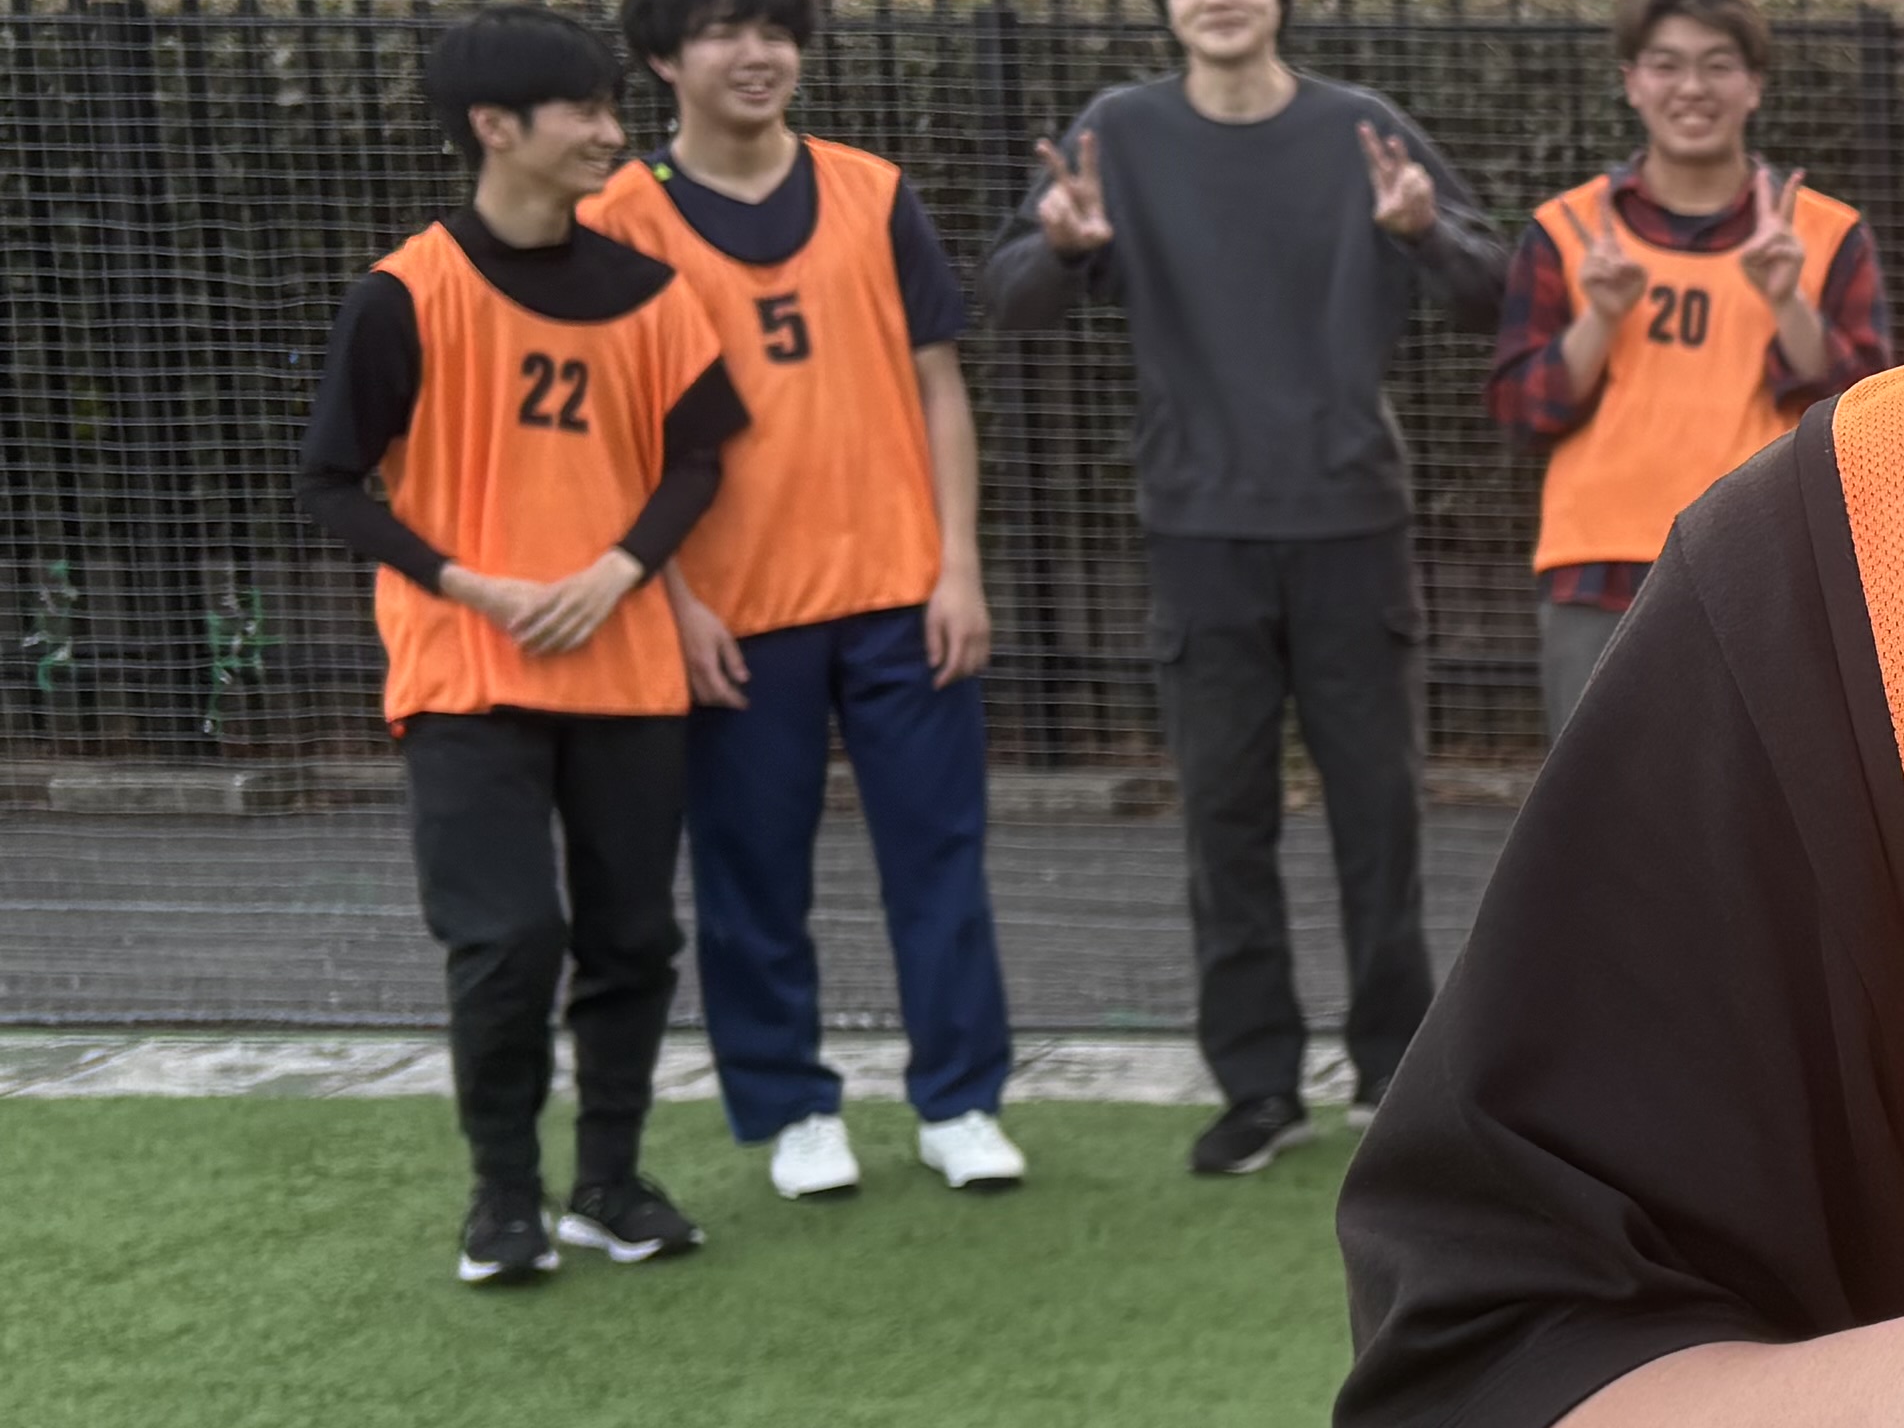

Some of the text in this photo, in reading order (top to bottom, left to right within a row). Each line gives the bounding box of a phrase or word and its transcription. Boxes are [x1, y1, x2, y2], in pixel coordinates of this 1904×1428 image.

[757, 292, 811, 363] 5
[1647, 285, 1709, 348] 20
[517, 352, 590, 434] 22
